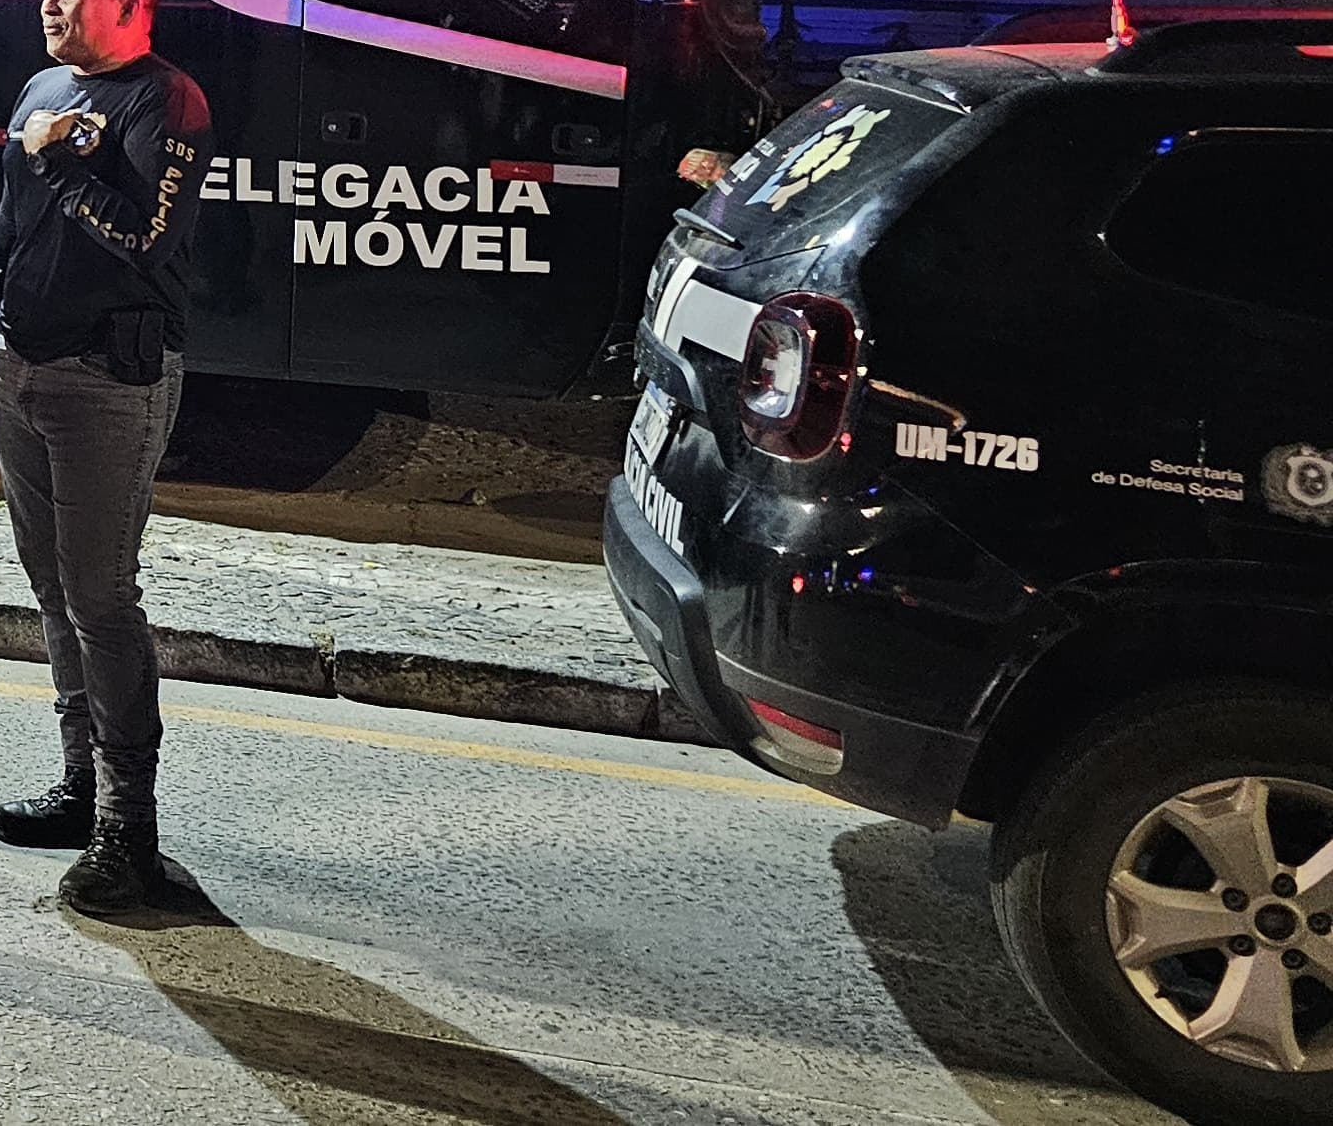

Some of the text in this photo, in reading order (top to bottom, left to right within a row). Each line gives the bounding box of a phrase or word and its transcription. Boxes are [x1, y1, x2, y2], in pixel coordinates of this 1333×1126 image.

[165, 138, 195, 162] SDS
[294, 211, 551, 274] MÓVEL
[895, 422, 1039, 472] UM-1726
[1091, 470, 1244, 502] de Defesa Social
[1150, 459, 1244, 484] Secretaria
